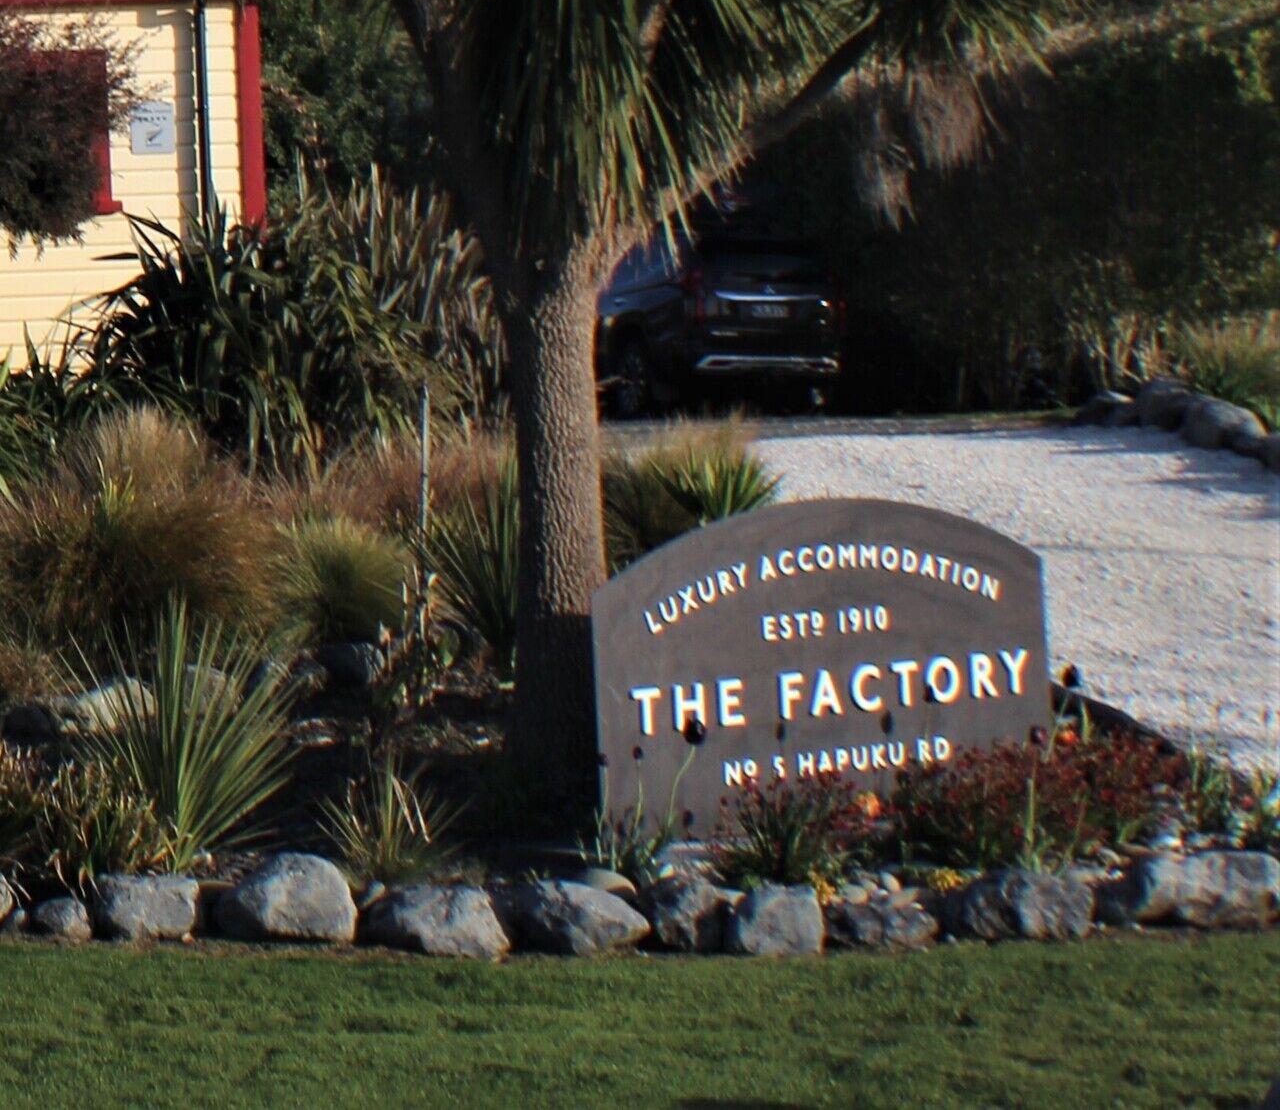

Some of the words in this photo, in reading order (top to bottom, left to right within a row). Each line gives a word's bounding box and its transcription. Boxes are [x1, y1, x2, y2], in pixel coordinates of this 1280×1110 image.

[643, 563, 747, 635] LUXURY
[758, 543, 1003, 602] ACCOMMODATION
[837, 604, 892, 634] 1910
[630, 678, 746, 736] THE
[777, 648, 1030, 721] FACTORY
[796, 740, 906, 778] HAPUKU
[916, 735, 953, 768] RD
